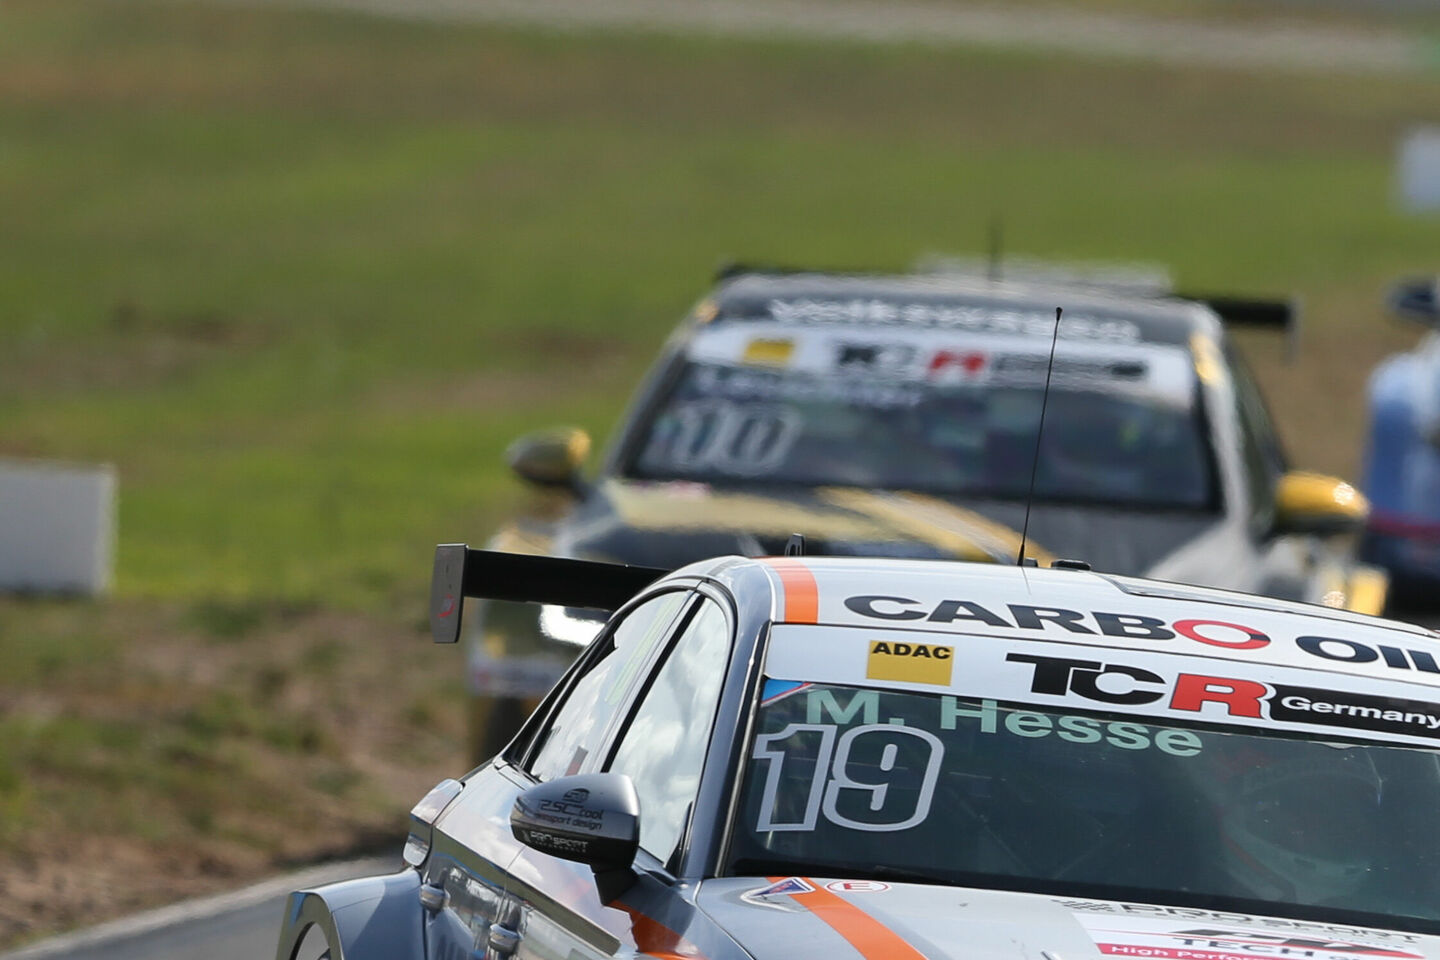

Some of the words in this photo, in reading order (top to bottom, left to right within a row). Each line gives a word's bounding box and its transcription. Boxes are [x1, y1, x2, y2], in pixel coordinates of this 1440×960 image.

[843, 595, 1271, 650] CARBO
[871, 641, 952, 660] ADAC
[1006, 653, 1268, 720] TCR
[940, 696, 1203, 757] Hesse
[752, 723, 945, 832] 19
[1110, 946, 1169, 957] High
[1172, 936, 1315, 958] TECH
